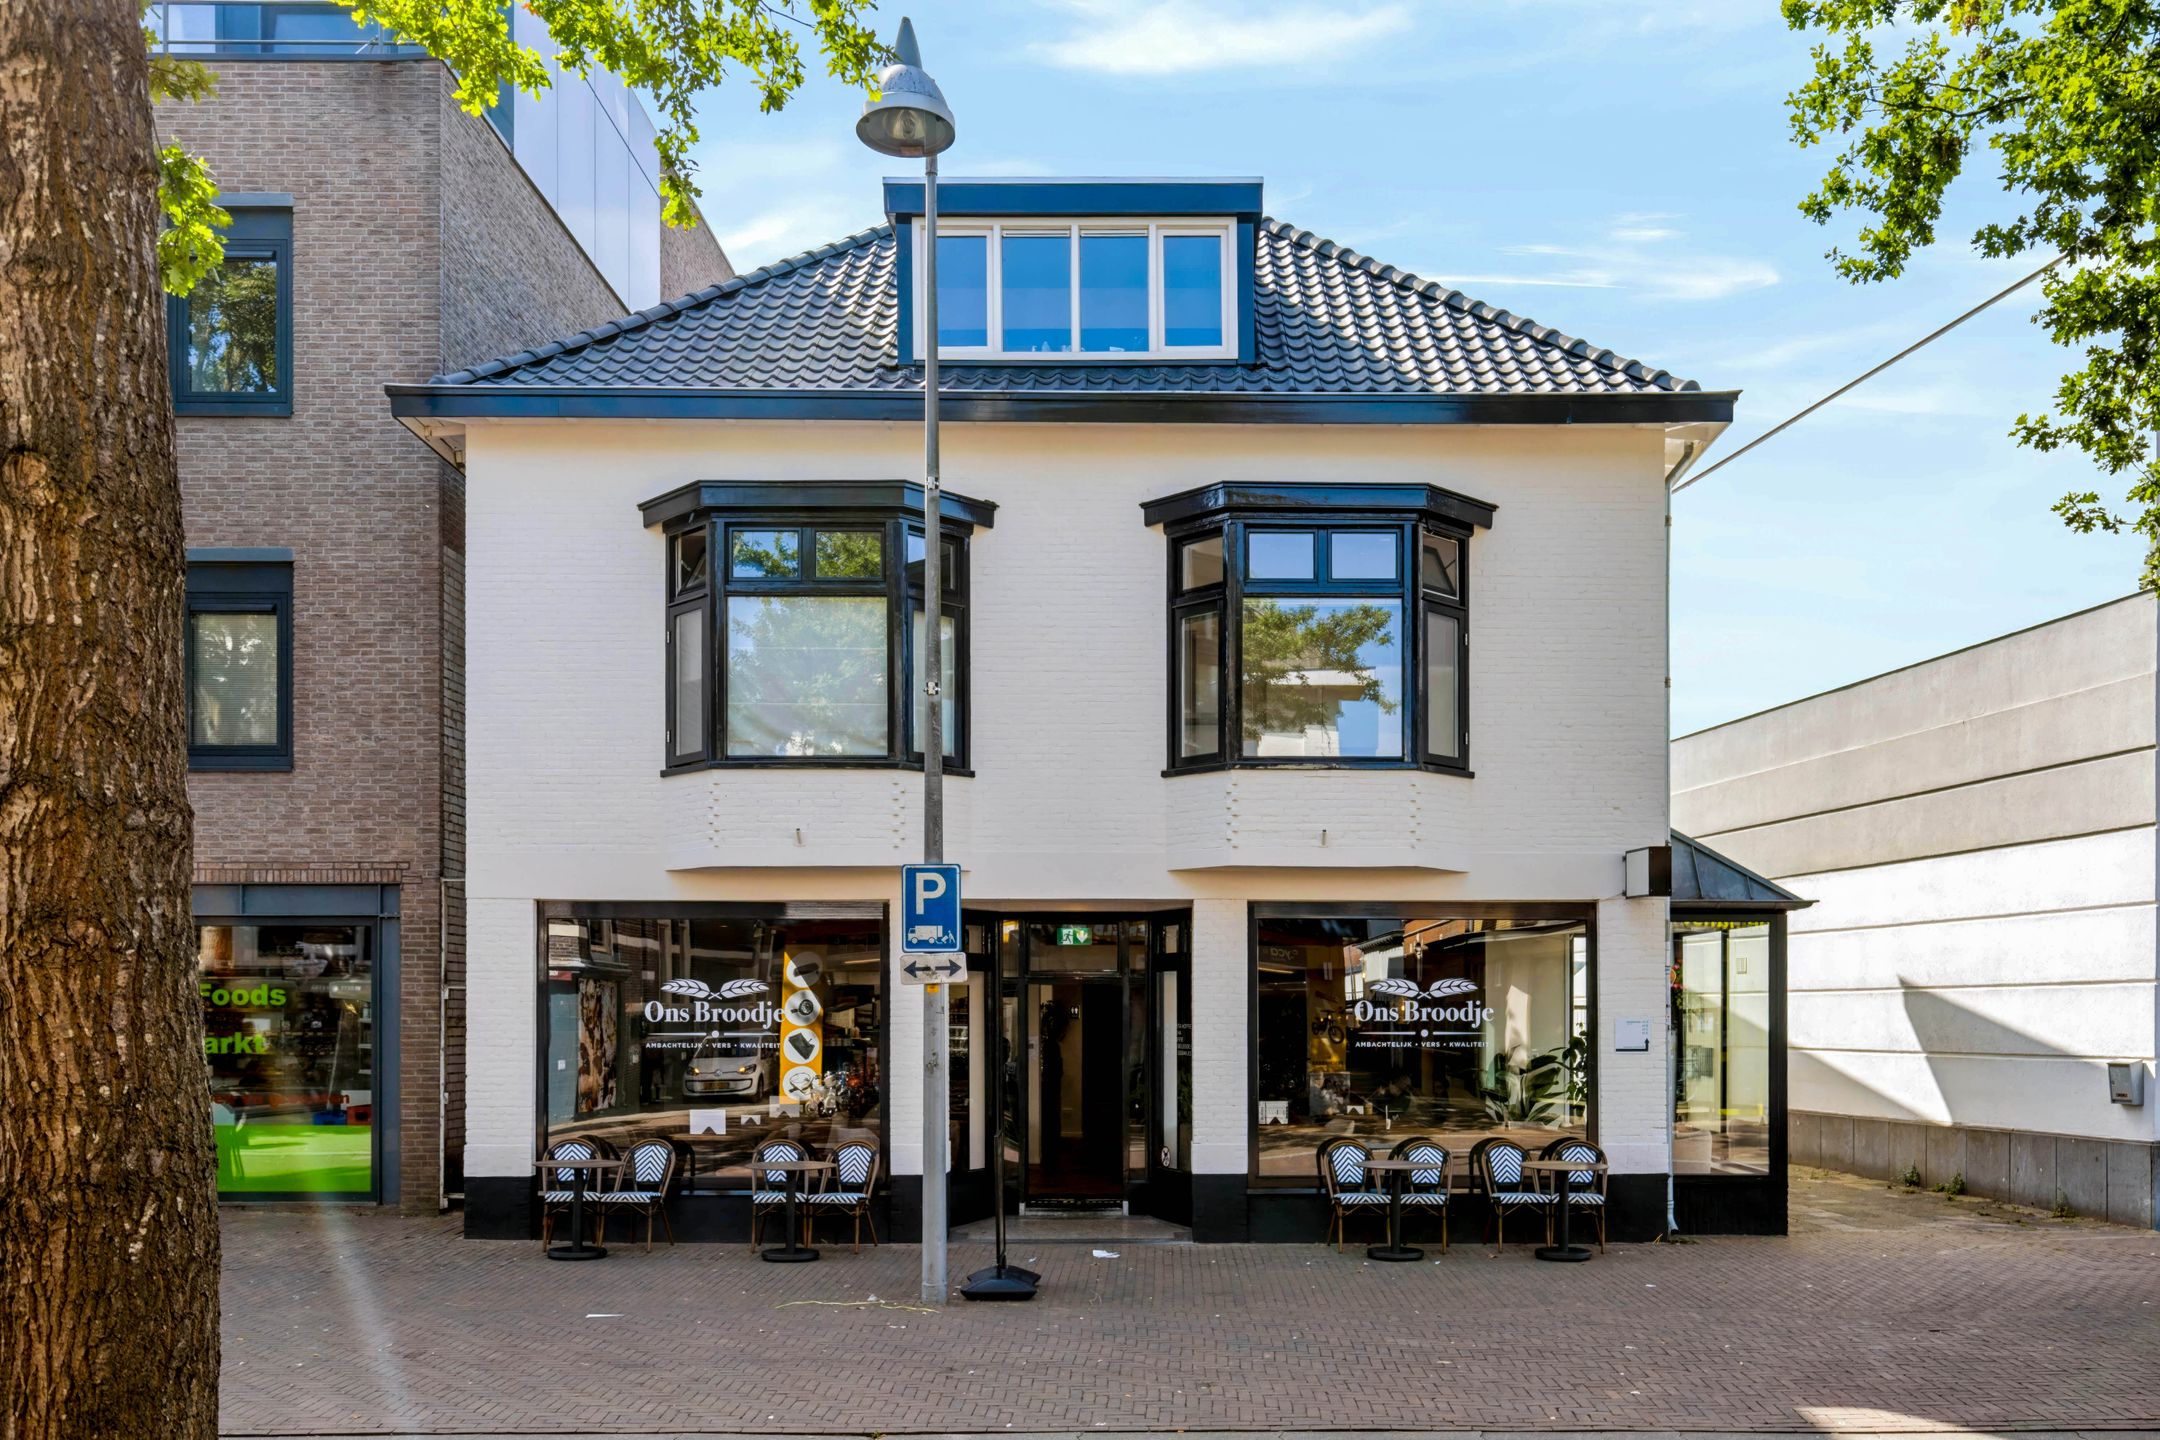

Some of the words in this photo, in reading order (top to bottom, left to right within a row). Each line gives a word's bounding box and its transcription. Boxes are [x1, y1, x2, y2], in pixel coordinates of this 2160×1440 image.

[915, 872, 947, 915] P
[199, 983, 287, 1006] Foods
[644, 1000, 690, 1023] Ons
[693, 1000, 786, 1030] Broodje
[1354, 1000, 1399, 1022] Ons
[1403, 1000, 1494, 1029] Broodje
[205, 1032, 266, 1055] arkt
